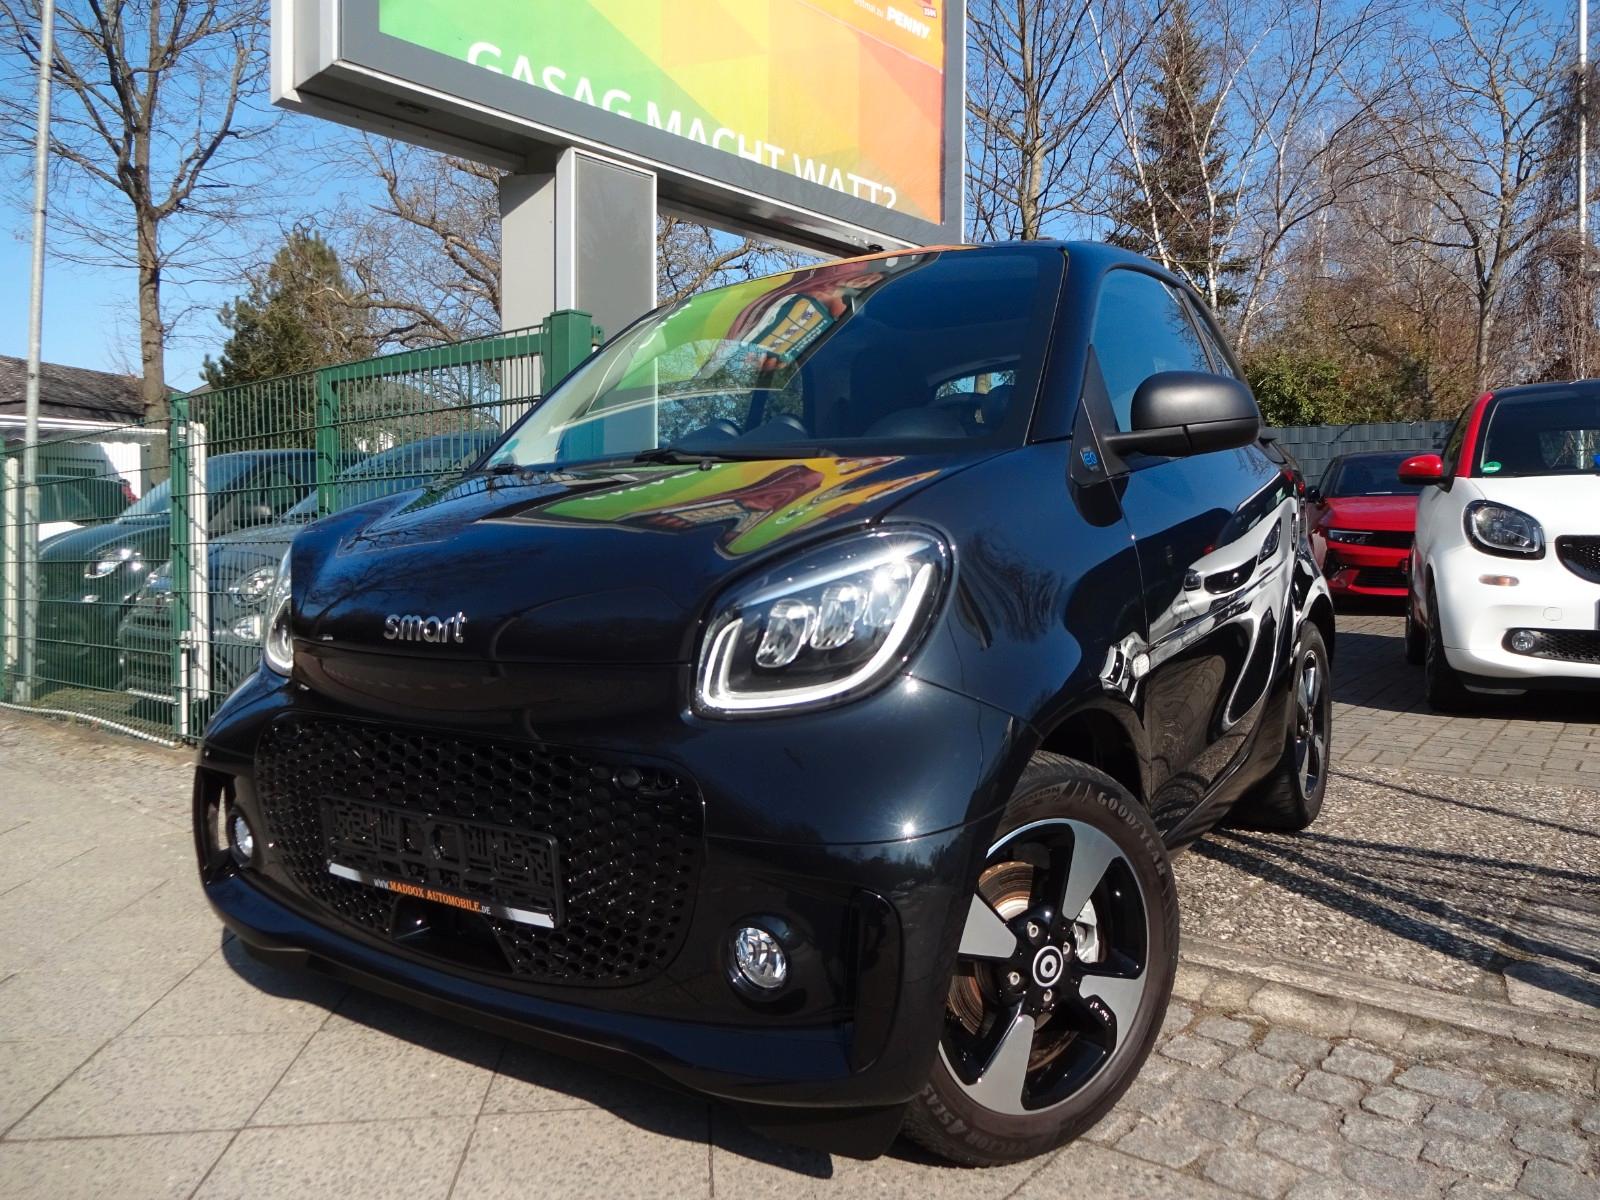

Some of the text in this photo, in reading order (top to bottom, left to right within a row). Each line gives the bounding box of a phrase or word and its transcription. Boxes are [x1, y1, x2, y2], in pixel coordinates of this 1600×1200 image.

[886, 6, 931, 39] PENNY
[467, 41, 897, 209] GASAG MACHT WATT?
[383, 611, 467, 644] smart
